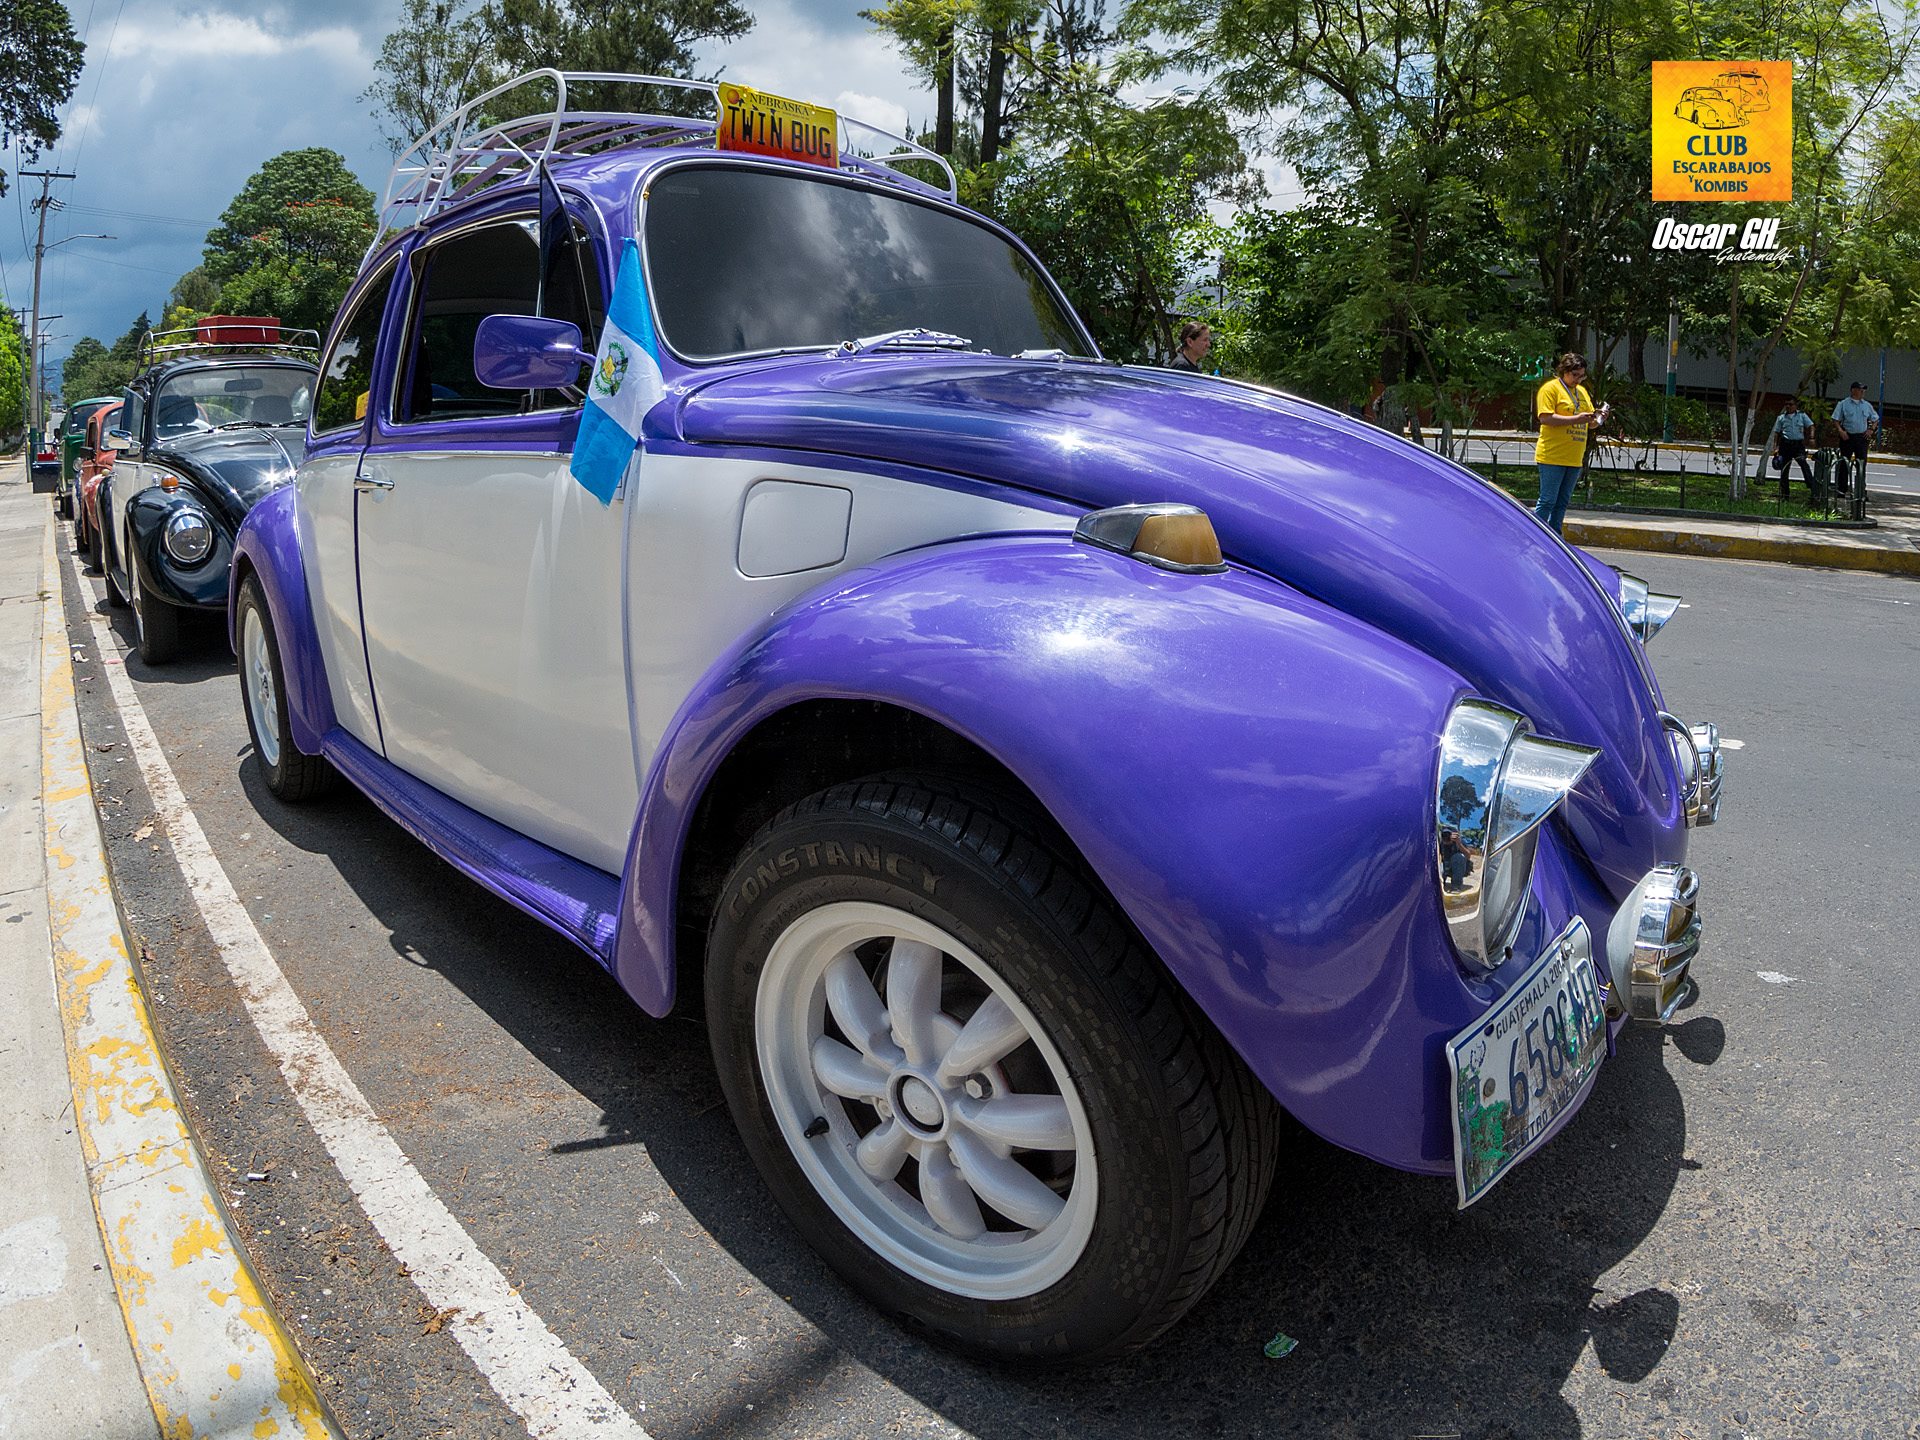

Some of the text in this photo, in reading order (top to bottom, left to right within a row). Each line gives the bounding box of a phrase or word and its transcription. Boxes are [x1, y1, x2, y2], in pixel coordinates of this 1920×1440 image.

[728, 105, 831, 159] TWIN BUG
[750, 93, 811, 117] NEBRASKA
[728, 840, 944, 922] CONSTANCY
[1495, 982, 1550, 1041] GUATEMALA
